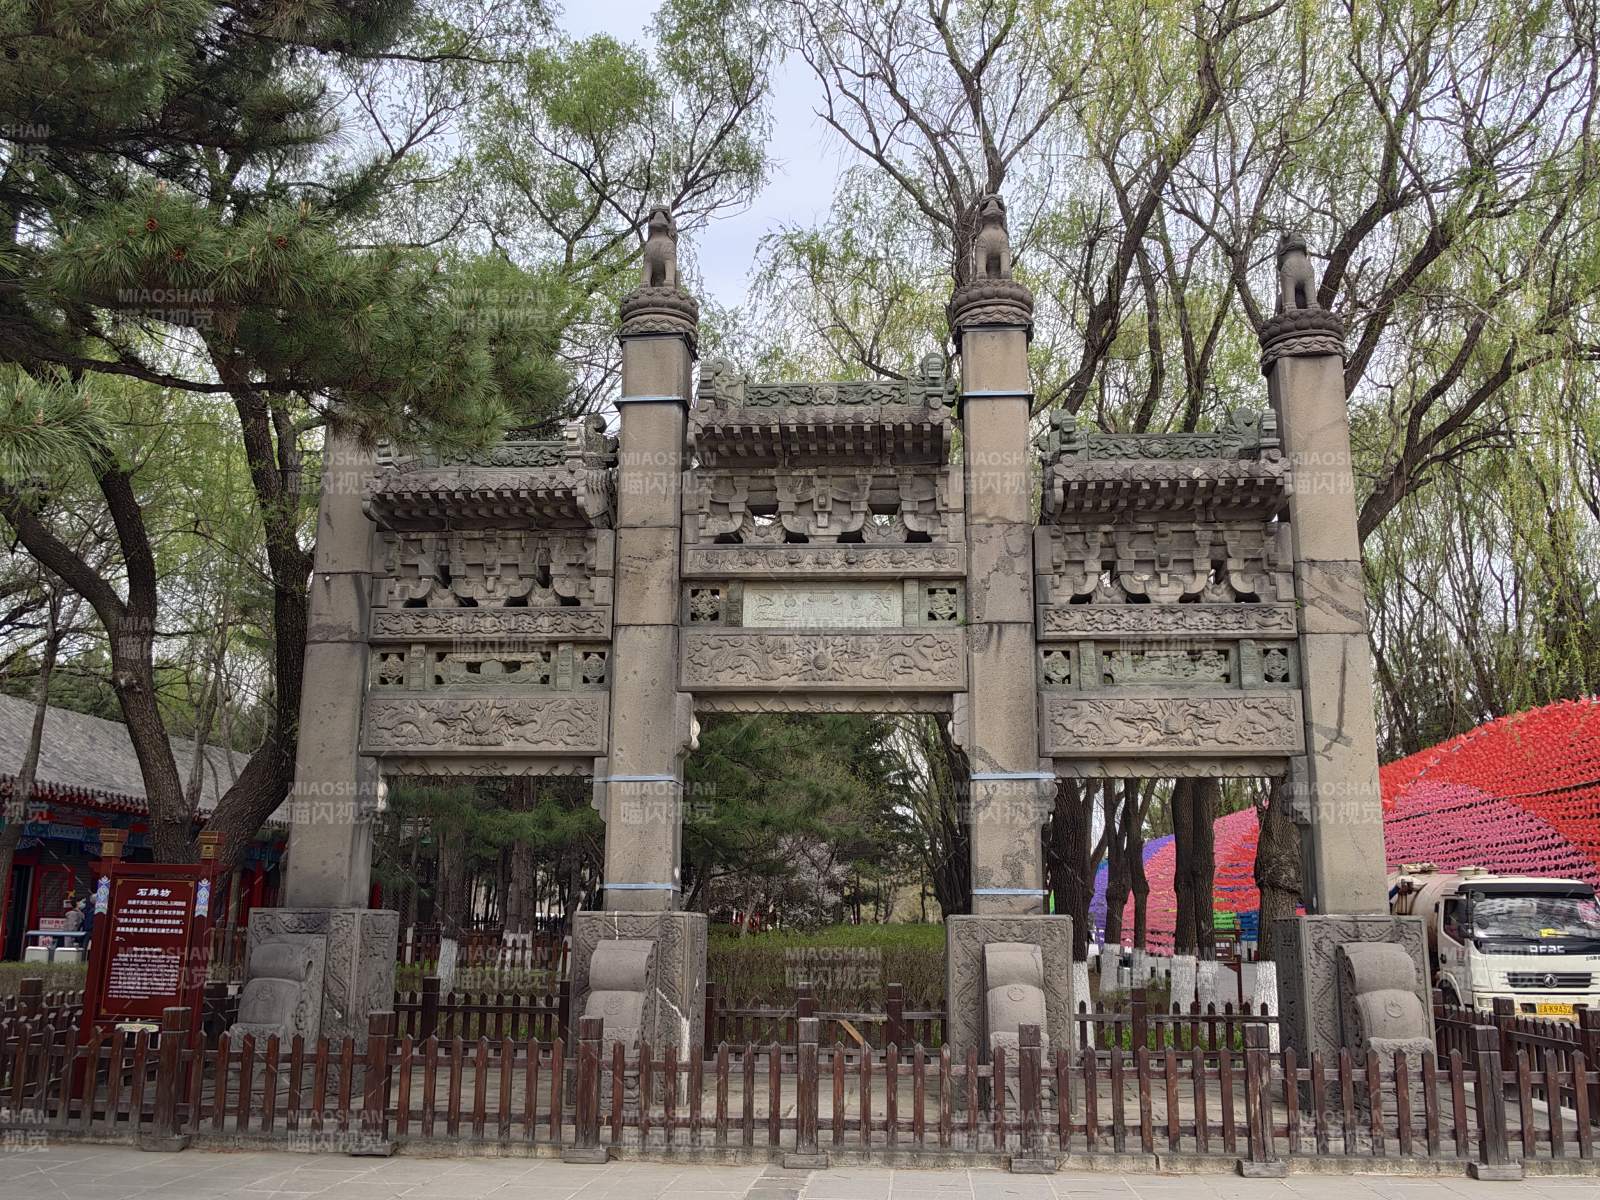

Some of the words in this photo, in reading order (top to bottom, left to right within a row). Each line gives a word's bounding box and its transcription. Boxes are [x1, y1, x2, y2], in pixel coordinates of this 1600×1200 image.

[136, 887, 172, 897] 石牌坊
[1529, 945, 1565, 953] DFAC
